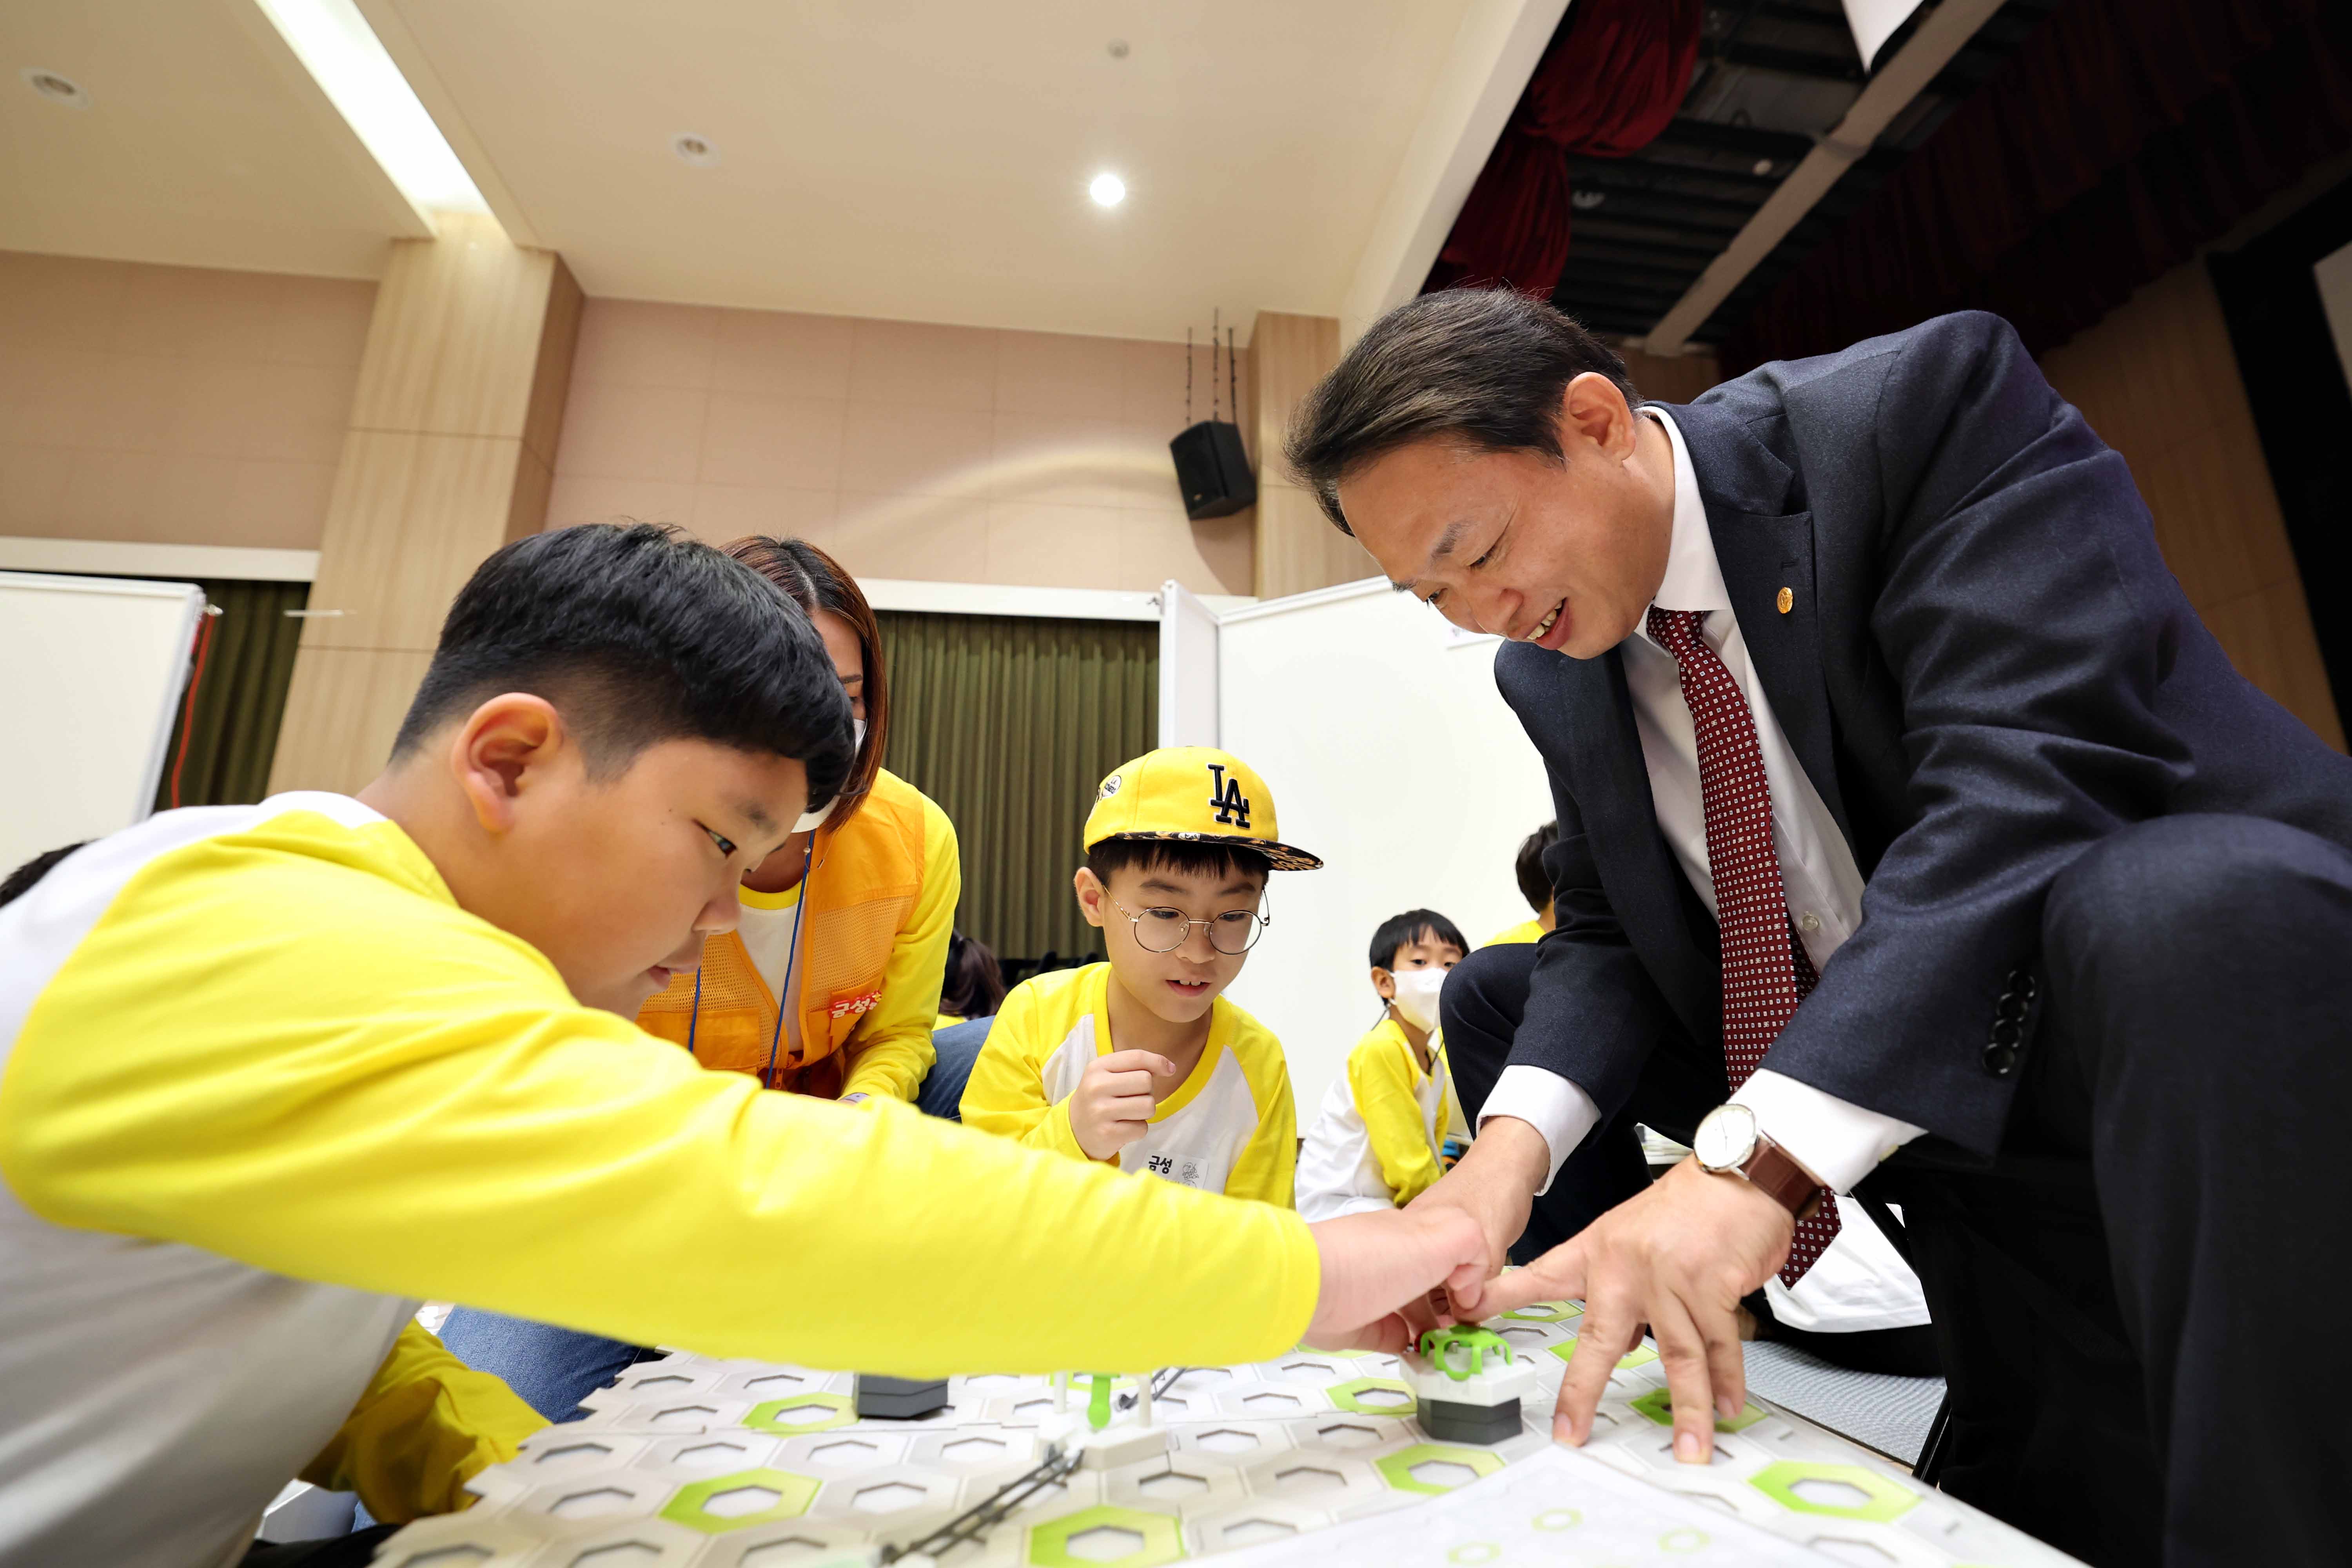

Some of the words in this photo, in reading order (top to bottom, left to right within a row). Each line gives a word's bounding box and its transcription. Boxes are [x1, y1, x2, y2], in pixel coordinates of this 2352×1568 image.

[1207, 764, 1250, 828] LA
[831, 998, 871, 1018] 금성
[1149, 1155, 1172, 1174] 금성
